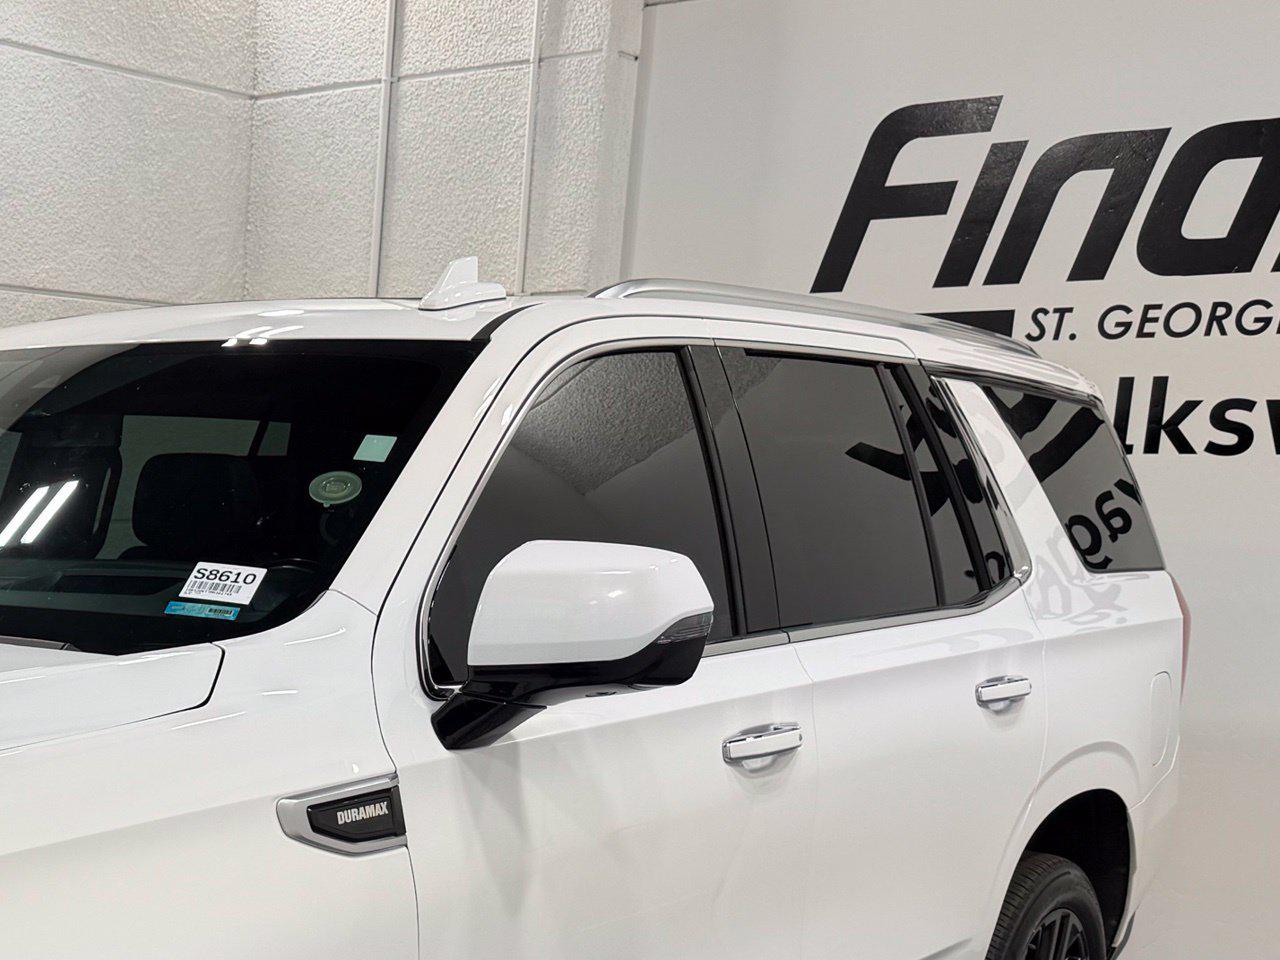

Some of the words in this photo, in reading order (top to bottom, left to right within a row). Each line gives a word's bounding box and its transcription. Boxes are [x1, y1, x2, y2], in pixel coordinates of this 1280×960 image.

[1025, 306, 1078, 341] ST.
[1097, 299, 1280, 340] GEORG
[193, 567, 257, 585] S8610
[336, 801, 389, 826] DURAMAX
